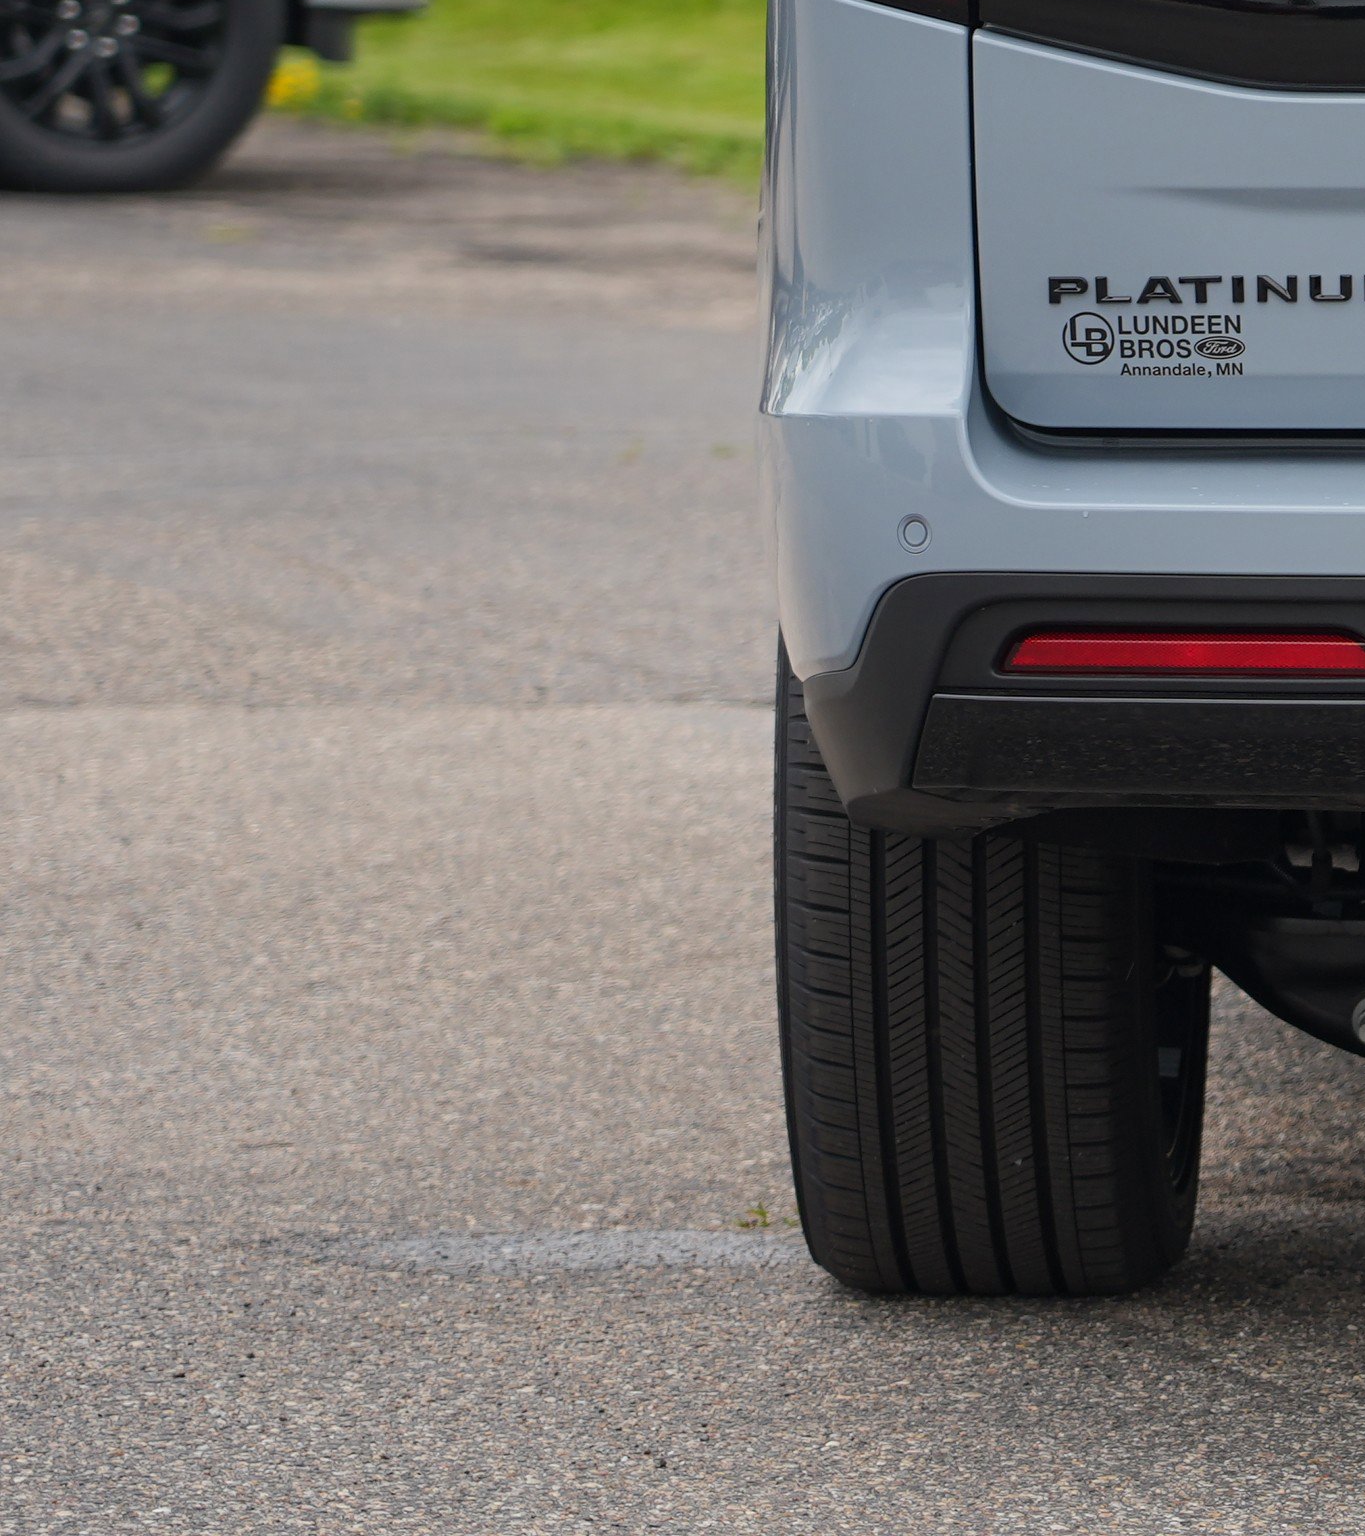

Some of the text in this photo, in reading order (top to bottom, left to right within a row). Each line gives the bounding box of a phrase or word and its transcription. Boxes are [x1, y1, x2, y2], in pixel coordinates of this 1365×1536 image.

[1117, 314, 1242, 335] LUNDEEN
[1119, 338, 1192, 359] BROS
[1120, 363, 1243, 378] Annandale, MN
